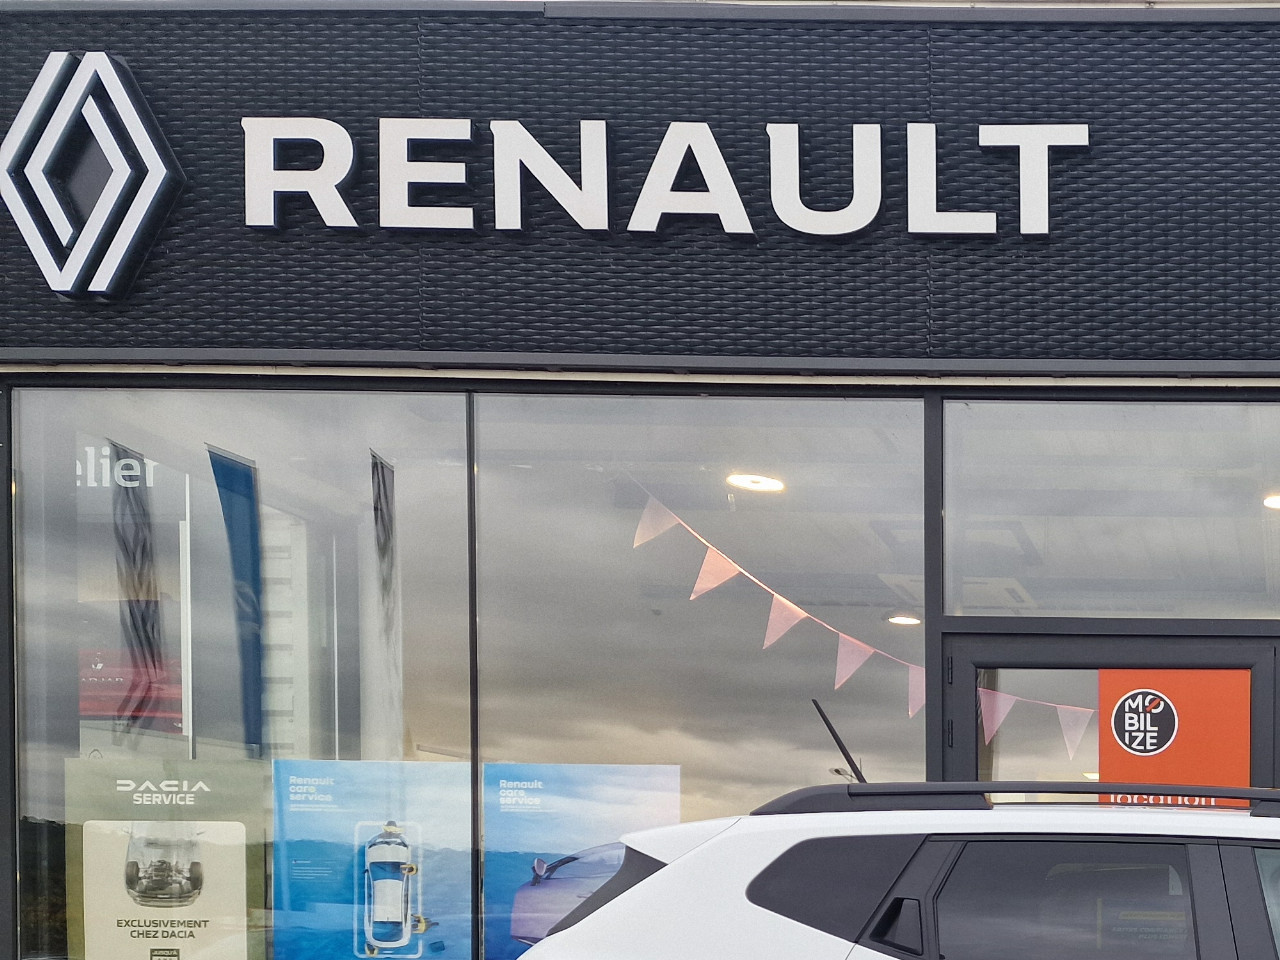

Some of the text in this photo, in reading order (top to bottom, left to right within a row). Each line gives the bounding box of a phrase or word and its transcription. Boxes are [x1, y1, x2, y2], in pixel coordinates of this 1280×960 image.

[241, 116, 1089, 236] RENAULT
[76, 446, 159, 488] lier
[1125, 713, 1158, 731] BIL
[1125, 732, 1158, 750] IZE
[289, 776, 335, 785] Renault
[499, 780, 544, 789] Renault
[116, 779, 212, 792] DACIA
[499, 789, 526, 797] care
[132, 793, 195, 805] SERVICE
[289, 794, 333, 802] service
[499, 797, 541, 805] service
[116, 919, 210, 928] EXCLUSIVEMENT
[130, 930, 196, 938] CHEZ DACIA
